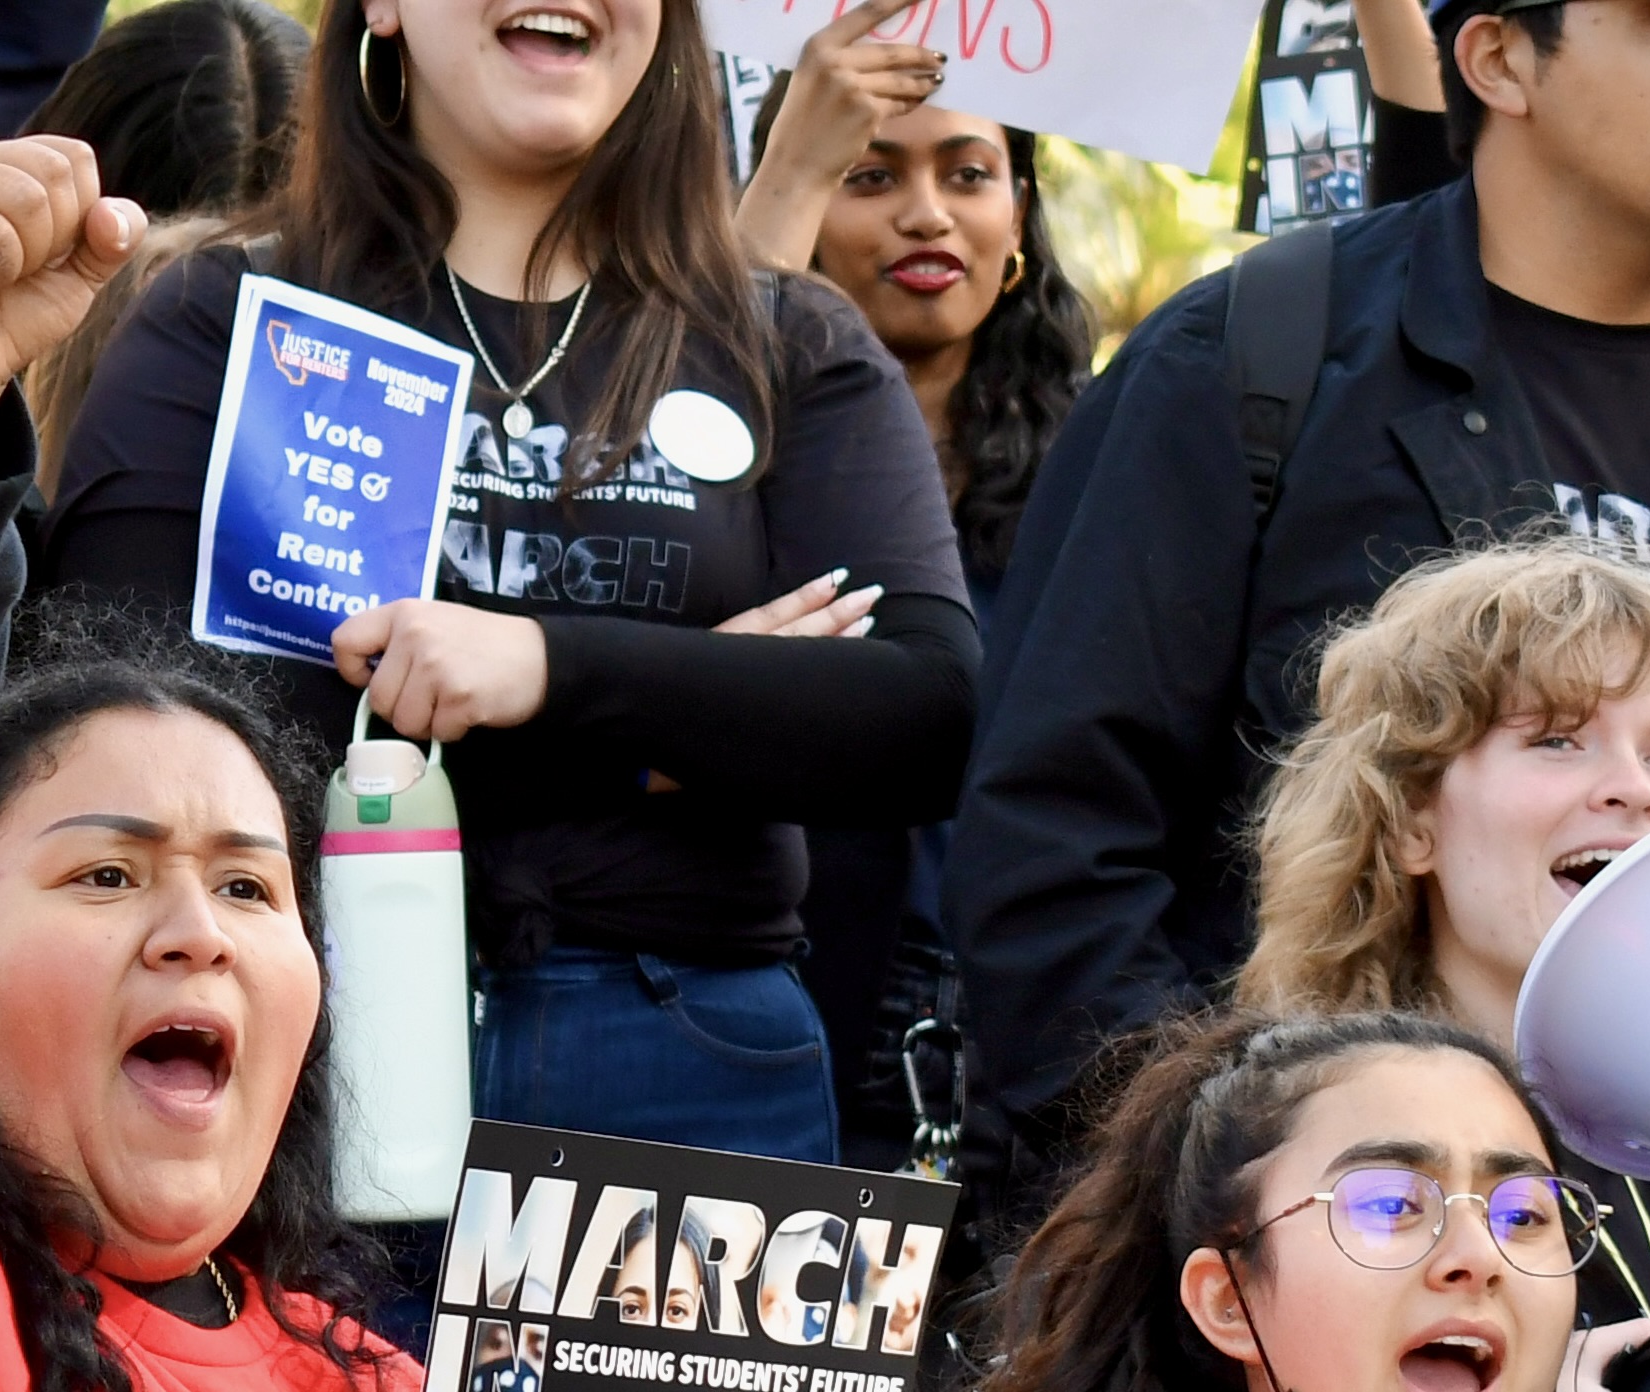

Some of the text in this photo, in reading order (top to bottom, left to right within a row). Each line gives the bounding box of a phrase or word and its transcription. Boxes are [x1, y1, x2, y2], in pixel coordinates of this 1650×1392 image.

[280, 331, 352, 370] JUSTICE
[366, 355, 449, 405] November
[383, 385, 426, 416] 2024
[302, 410, 384, 459] Vote
[284, 447, 355, 491] YES
[451, 470, 525, 500] ECURING
[625, 484, 697, 512] FUTURE
[302, 494, 356, 531] for
[448, 492, 479, 513] 024
[276, 531, 365, 576] Rent
[440, 518, 691, 613] ARCH
[441, 1167, 944, 1359] MARCH
[553, 1338, 677, 1385] SECURING
